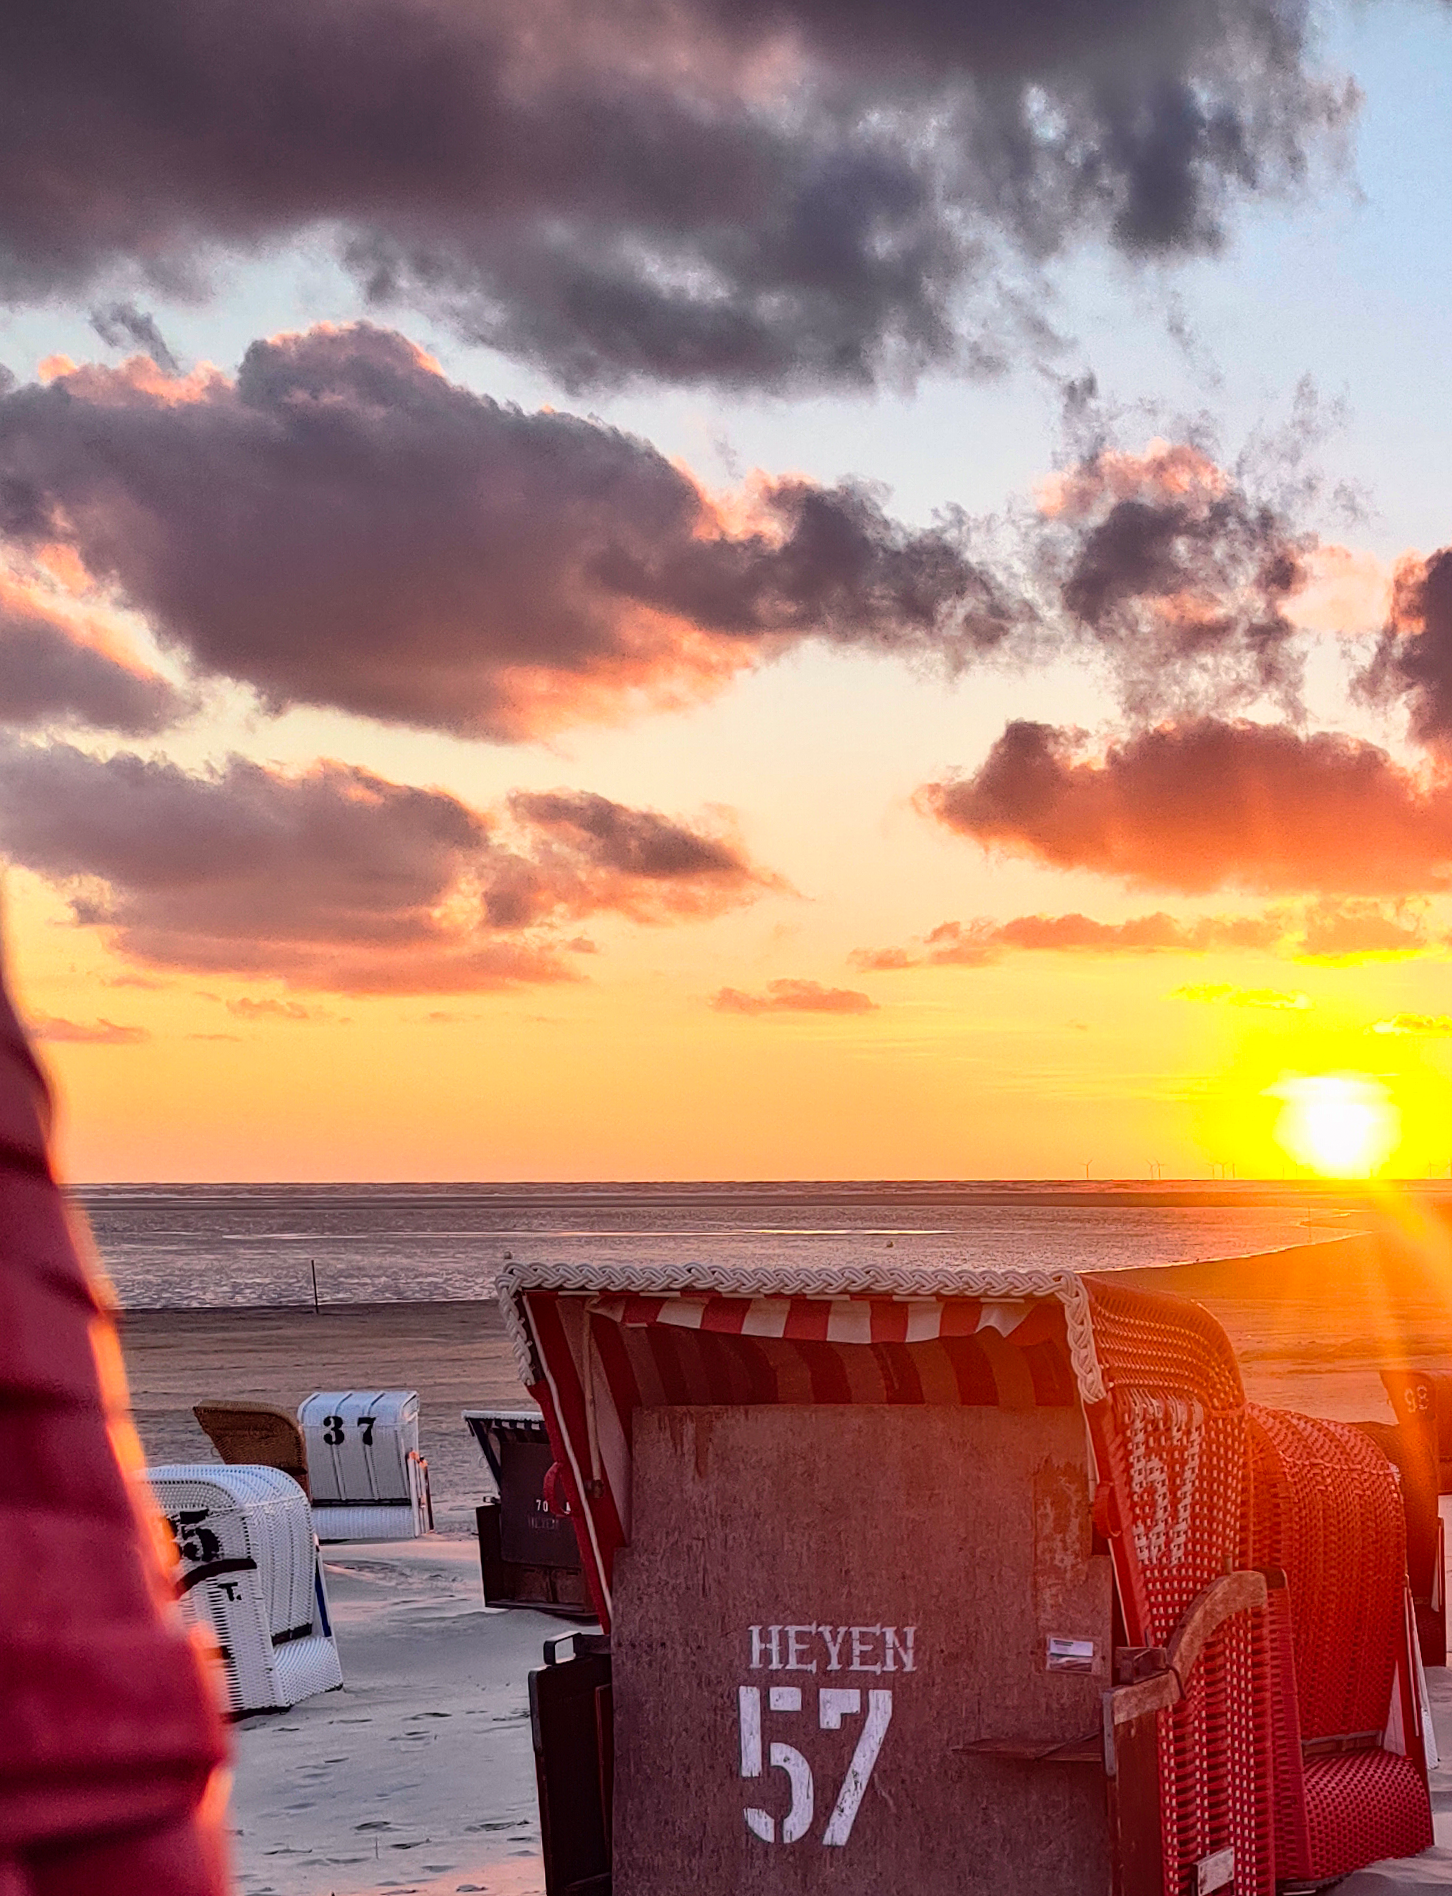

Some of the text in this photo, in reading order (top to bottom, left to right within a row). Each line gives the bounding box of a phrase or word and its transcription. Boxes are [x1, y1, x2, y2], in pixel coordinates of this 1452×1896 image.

[1131, 1389, 1204, 1566] 57
[748, 1621, 917, 1674] HEYEN
[739, 1686, 892, 1846] 57
